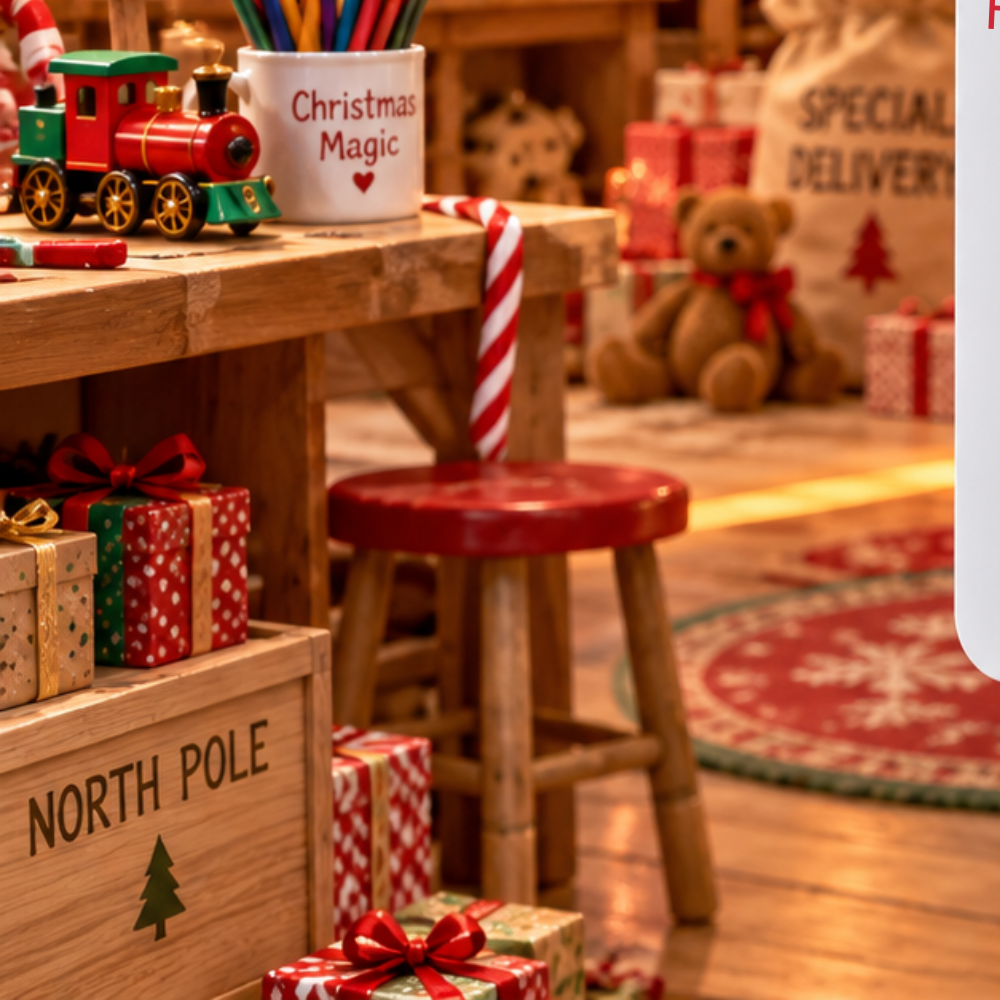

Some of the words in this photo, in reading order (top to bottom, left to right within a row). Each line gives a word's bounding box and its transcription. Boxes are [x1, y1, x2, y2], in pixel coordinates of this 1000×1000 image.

[291, 90, 417, 124] Christmas
[800, 84, 955, 138] SPECIAL
[319, 129, 400, 167] Magic
[28, 754, 161, 856] NORTH
[180, 719, 269, 801] POLE
